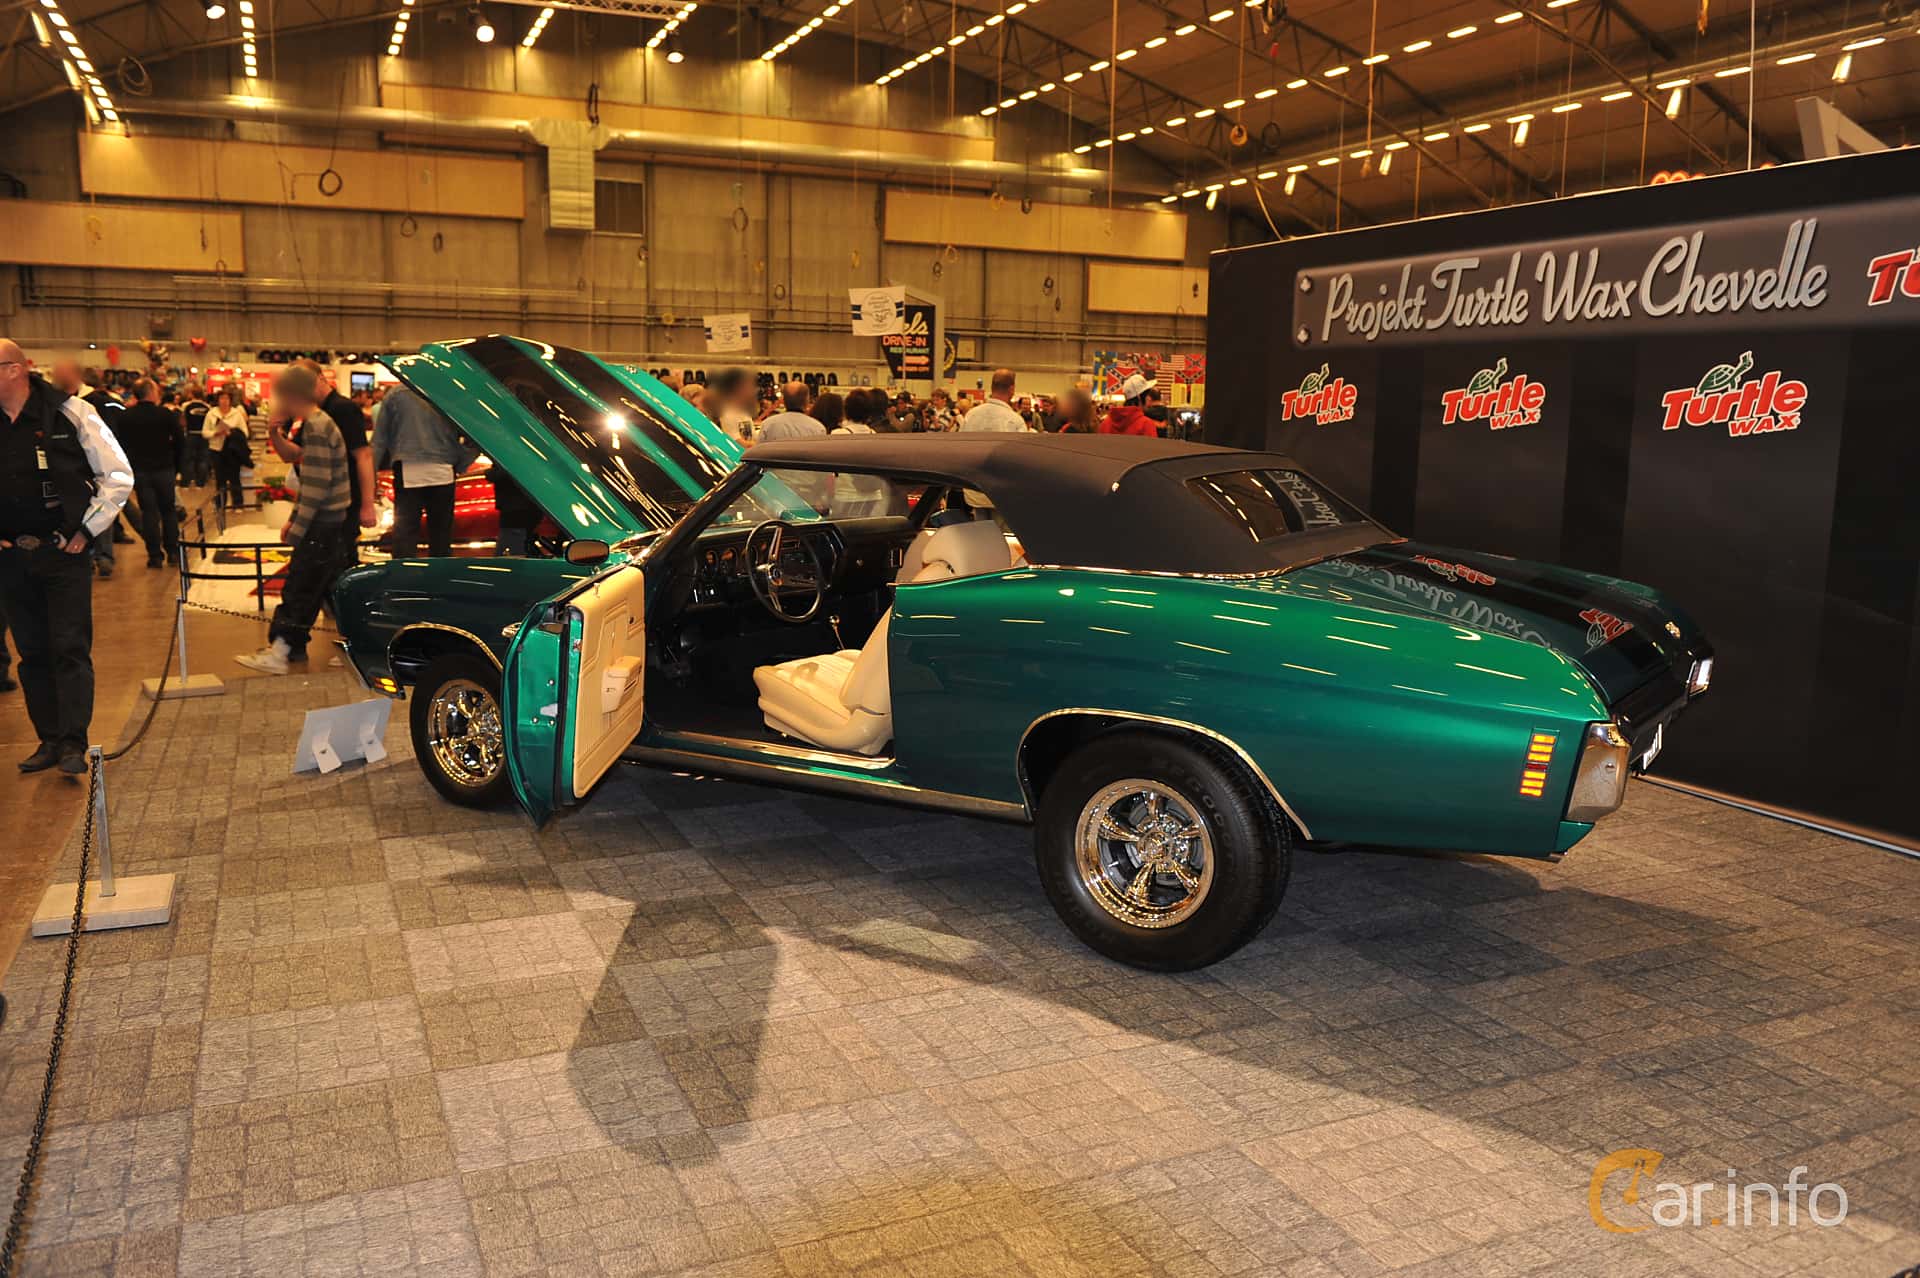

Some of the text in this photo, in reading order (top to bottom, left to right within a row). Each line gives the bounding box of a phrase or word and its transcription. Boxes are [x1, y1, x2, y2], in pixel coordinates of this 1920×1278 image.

[1320, 216, 1829, 342] Projekt Turtle Wax Chevelle
[1281, 377, 1358, 421] Turtle
[1315, 408, 1355, 426] WAX
[1441, 374, 1546, 425] Turtle
[1489, 408, 1542, 430] WAX
[1660, 370, 1809, 431] Turtle
[1728, 411, 1802, 437] WAX
